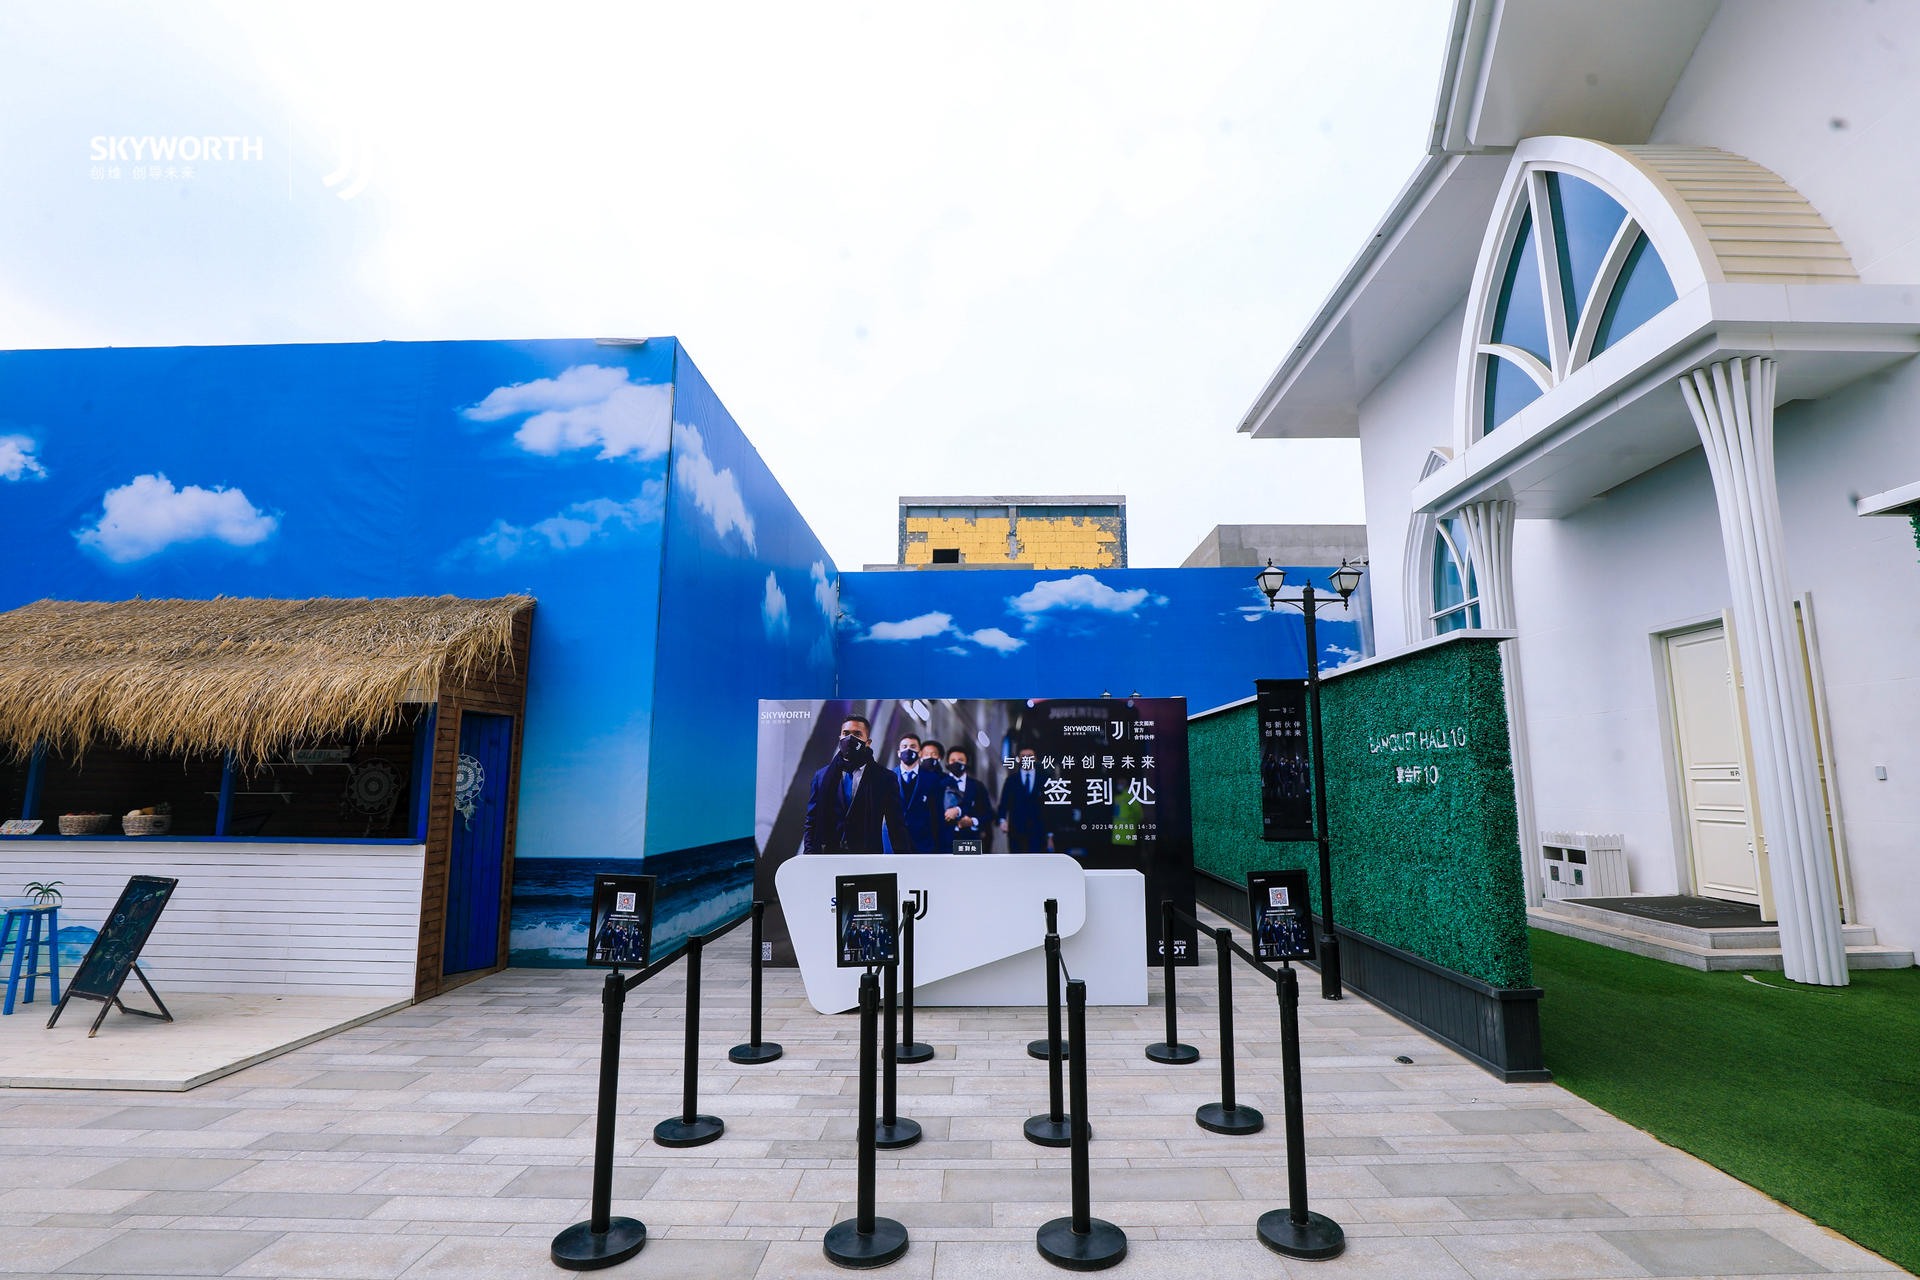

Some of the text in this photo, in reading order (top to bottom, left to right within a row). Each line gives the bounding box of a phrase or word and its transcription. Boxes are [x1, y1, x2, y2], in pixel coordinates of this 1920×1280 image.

[760, 711, 811, 720] SKYWORTH
[1264, 720, 1301, 729] 与新伙伴
[1264, 729, 1302, 737] 创导未来
[1419, 728, 1449, 750] HALL
[1450, 726, 1466, 747] 10
[1002, 755, 1156, 770] 与新伙伴创导未来
[1043, 777, 1156, 806] 签到处
